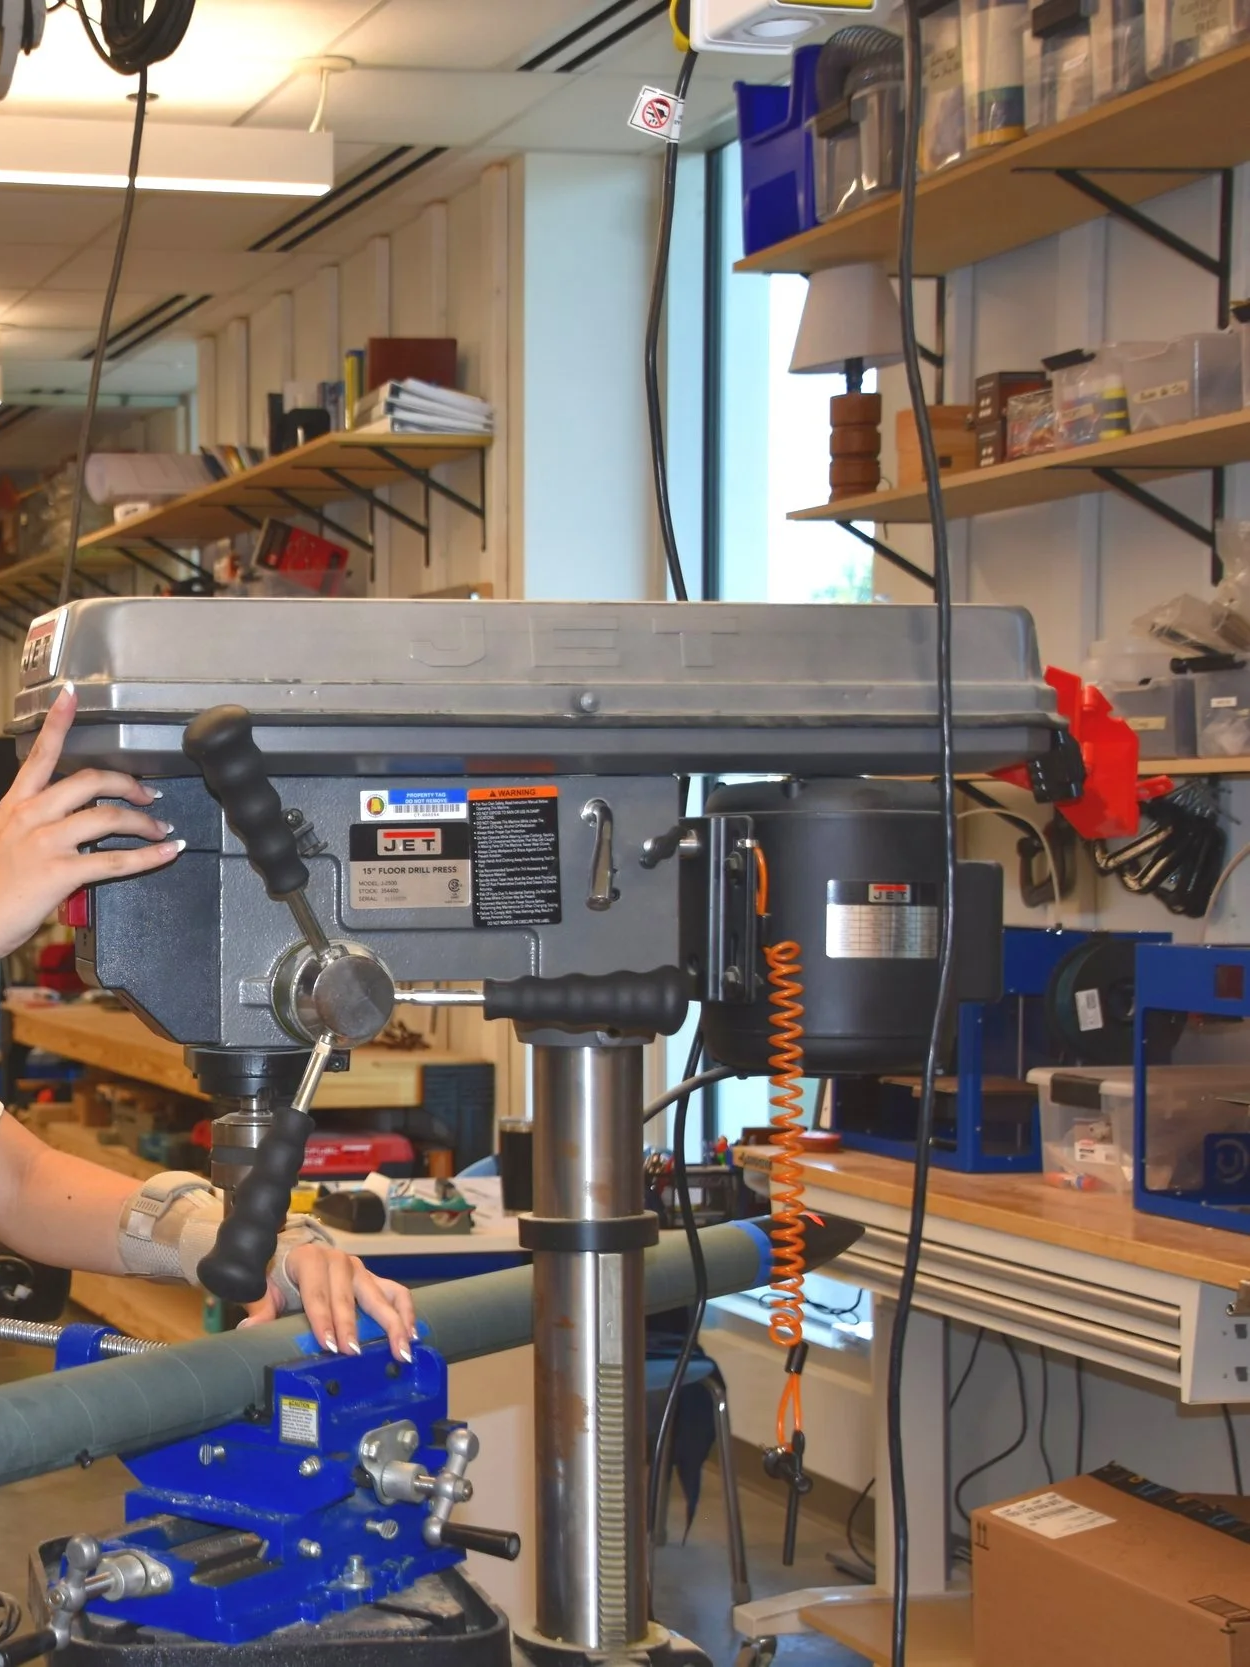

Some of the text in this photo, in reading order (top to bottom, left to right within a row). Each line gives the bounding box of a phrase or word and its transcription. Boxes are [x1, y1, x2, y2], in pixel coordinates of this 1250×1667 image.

[23, 634, 51, 672] JET
[497, 788, 536, 797] WARNING
[383, 839, 435, 851] JET
[873, 891, 907, 900] JET
